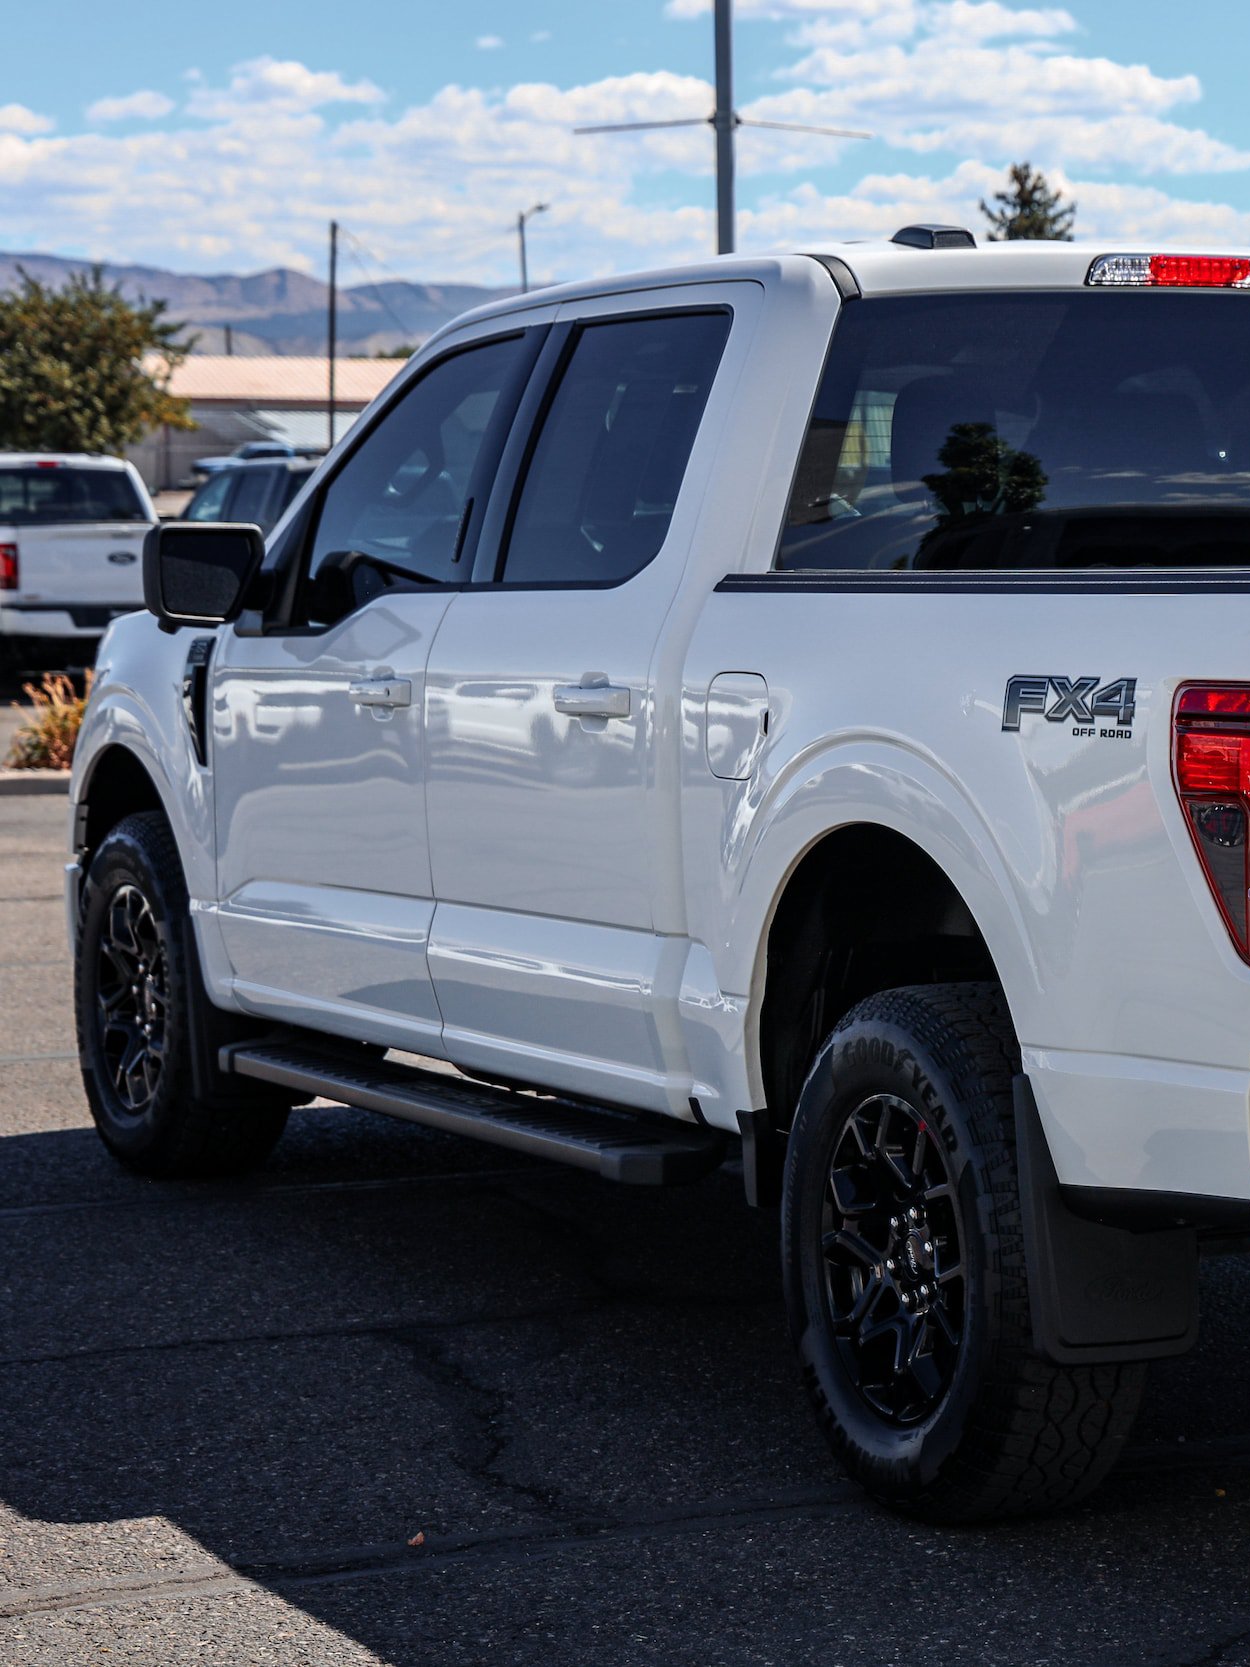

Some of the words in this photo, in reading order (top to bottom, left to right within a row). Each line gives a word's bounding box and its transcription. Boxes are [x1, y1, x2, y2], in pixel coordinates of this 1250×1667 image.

[1001, 674, 1138, 732] FX4
[1072, 727, 1096, 738] OFF
[1100, 728, 1132, 739] ROAD
